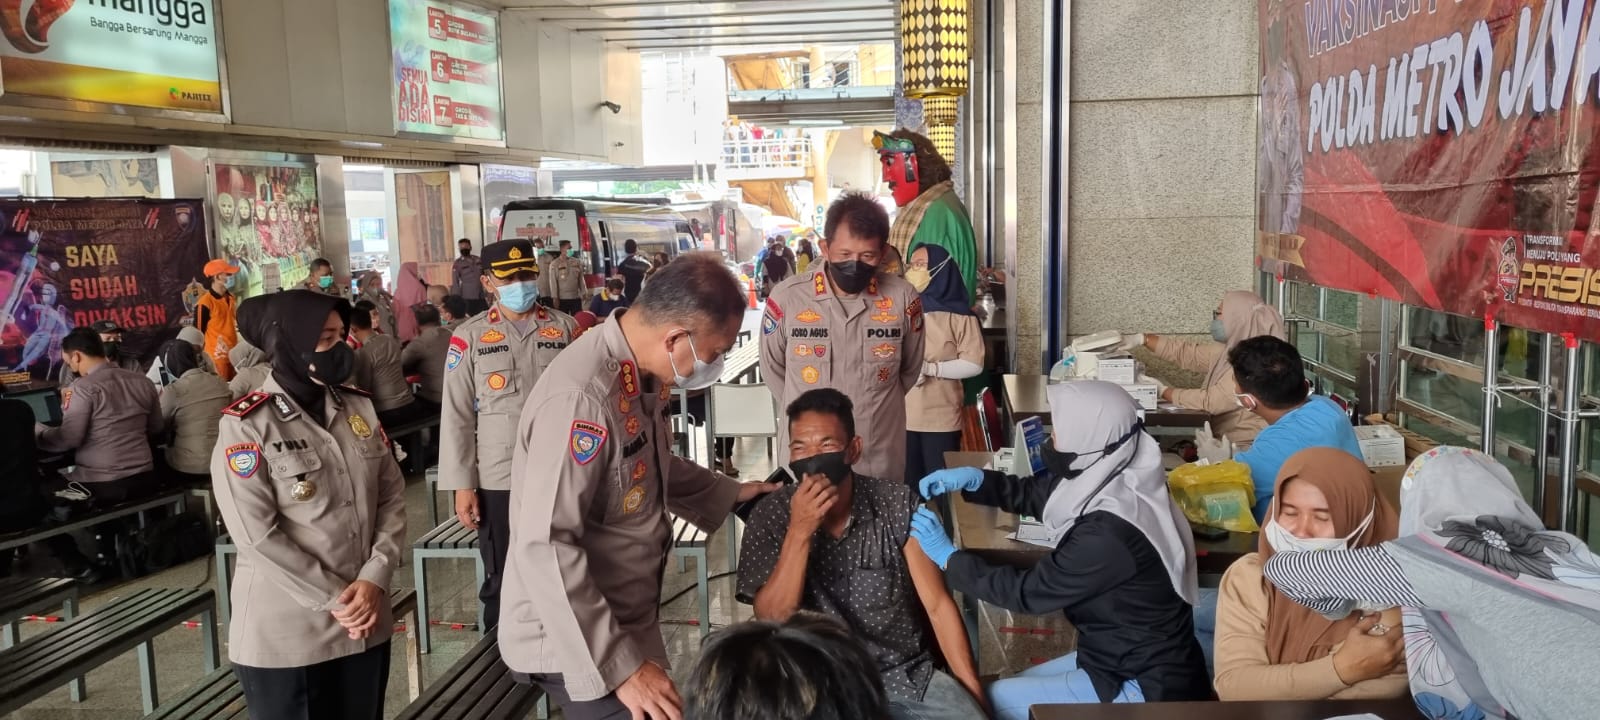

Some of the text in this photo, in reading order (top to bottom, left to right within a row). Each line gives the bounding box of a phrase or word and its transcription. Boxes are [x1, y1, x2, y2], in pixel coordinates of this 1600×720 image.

[90, 16, 208, 45] Bangga Bersarung Mangga
[434, 19, 441, 35] 5
[401, 67, 428, 84] SEMUA
[437, 62, 444, 78] 6
[399, 80, 430, 109] ADA
[1307, 64, 1377, 153] POLDA
[1381, 19, 1493, 136] METRO
[398, 104, 432, 124] DISINI
[439, 106, 447, 121] 7
[65, 244, 119, 268] SAYA
[70, 275, 139, 300] SUDAH
[74, 303, 167, 328] DIVAKSIN
[791, 328, 829, 337] JOKO AGUS
[868, 328, 901, 338] POLRI
[478, 344, 509, 356] SUJANTO
[272, 439, 308, 453] YULI
